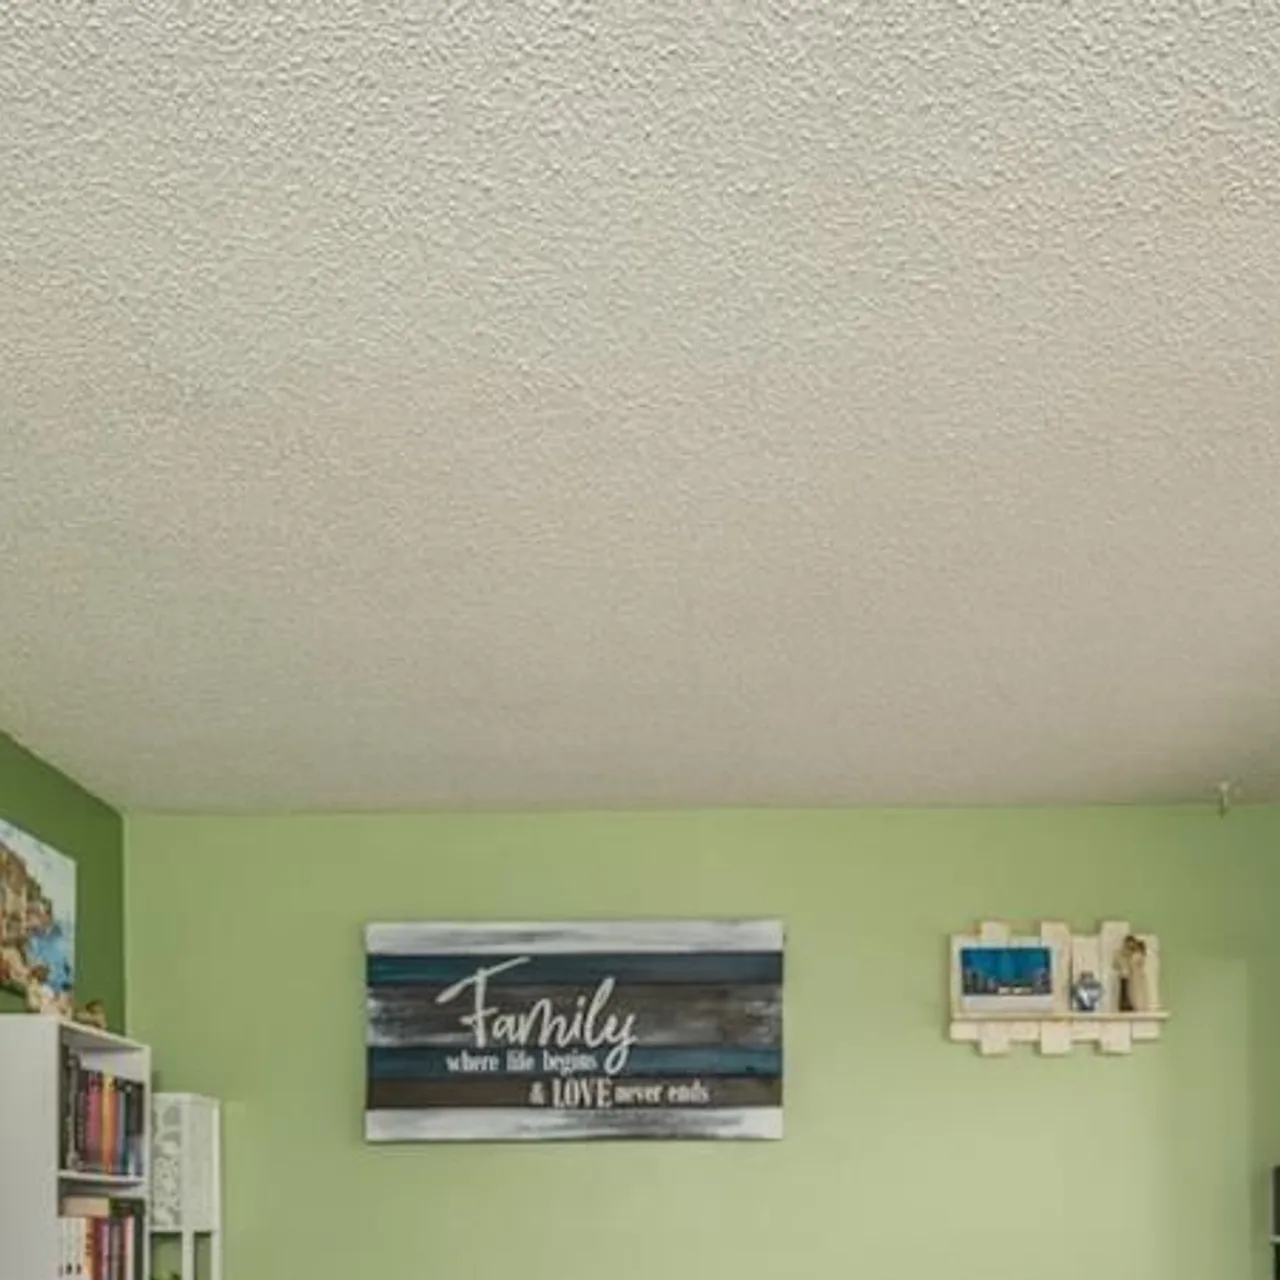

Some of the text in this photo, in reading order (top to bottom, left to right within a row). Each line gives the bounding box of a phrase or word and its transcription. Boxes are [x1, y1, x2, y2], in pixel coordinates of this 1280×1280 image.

[435, 955, 638, 1074] Family
[446, 1048, 598, 1075] where life begins
[529, 1077, 710, 1108] & LOVE never ends
